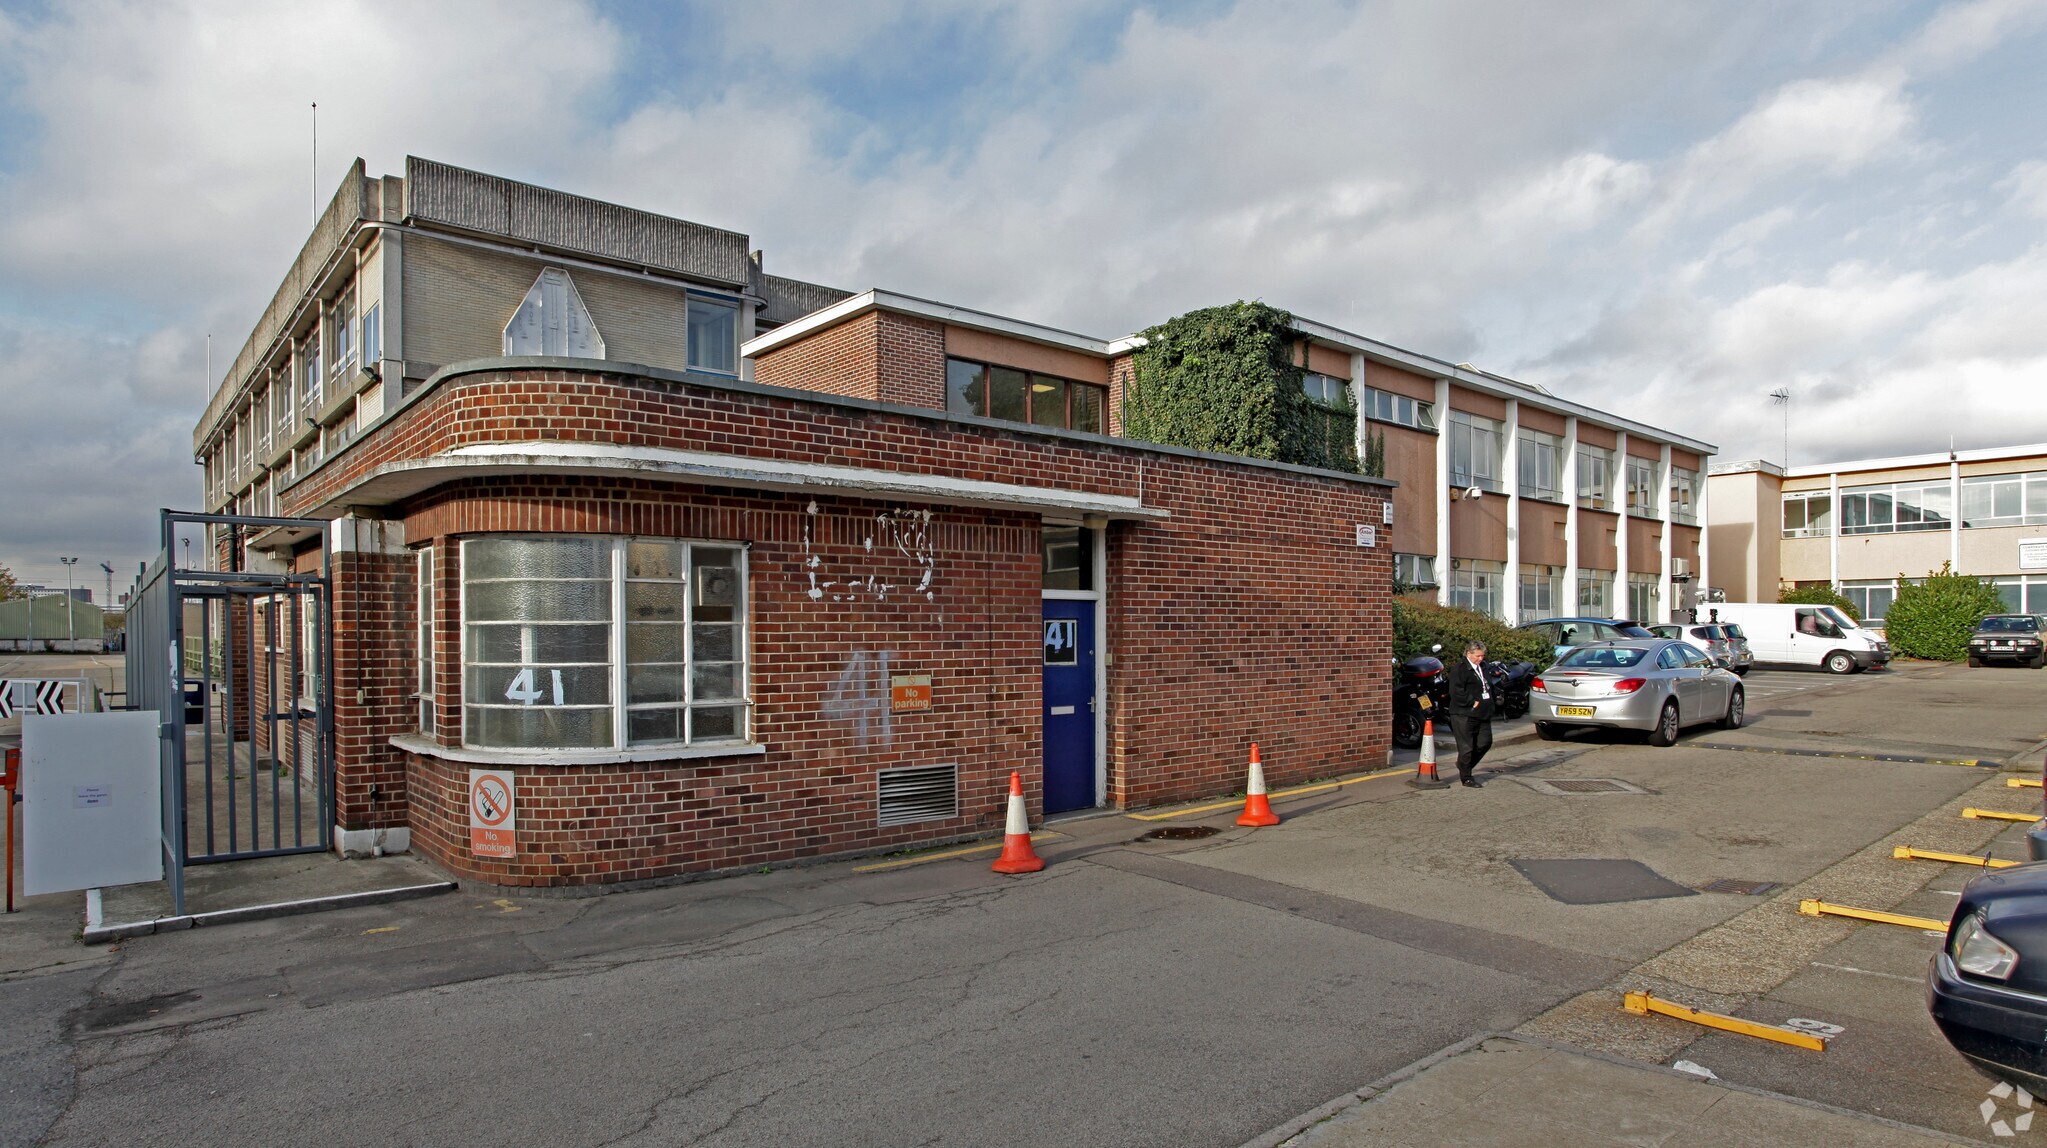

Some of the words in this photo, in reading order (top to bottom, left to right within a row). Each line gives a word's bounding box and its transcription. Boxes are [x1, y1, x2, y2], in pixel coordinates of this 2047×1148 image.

[1045, 621, 1073, 651] 41
[505, 668, 564, 706] 41
[905, 688, 918, 698] No
[821, 647, 892, 750] 41
[895, 698, 929, 709] parking
[1559, 707, 1577, 715] YR59
[1578, 708, 1592, 716] SZN
[485, 831, 498, 840] No
[475, 842, 511, 855] smoking
